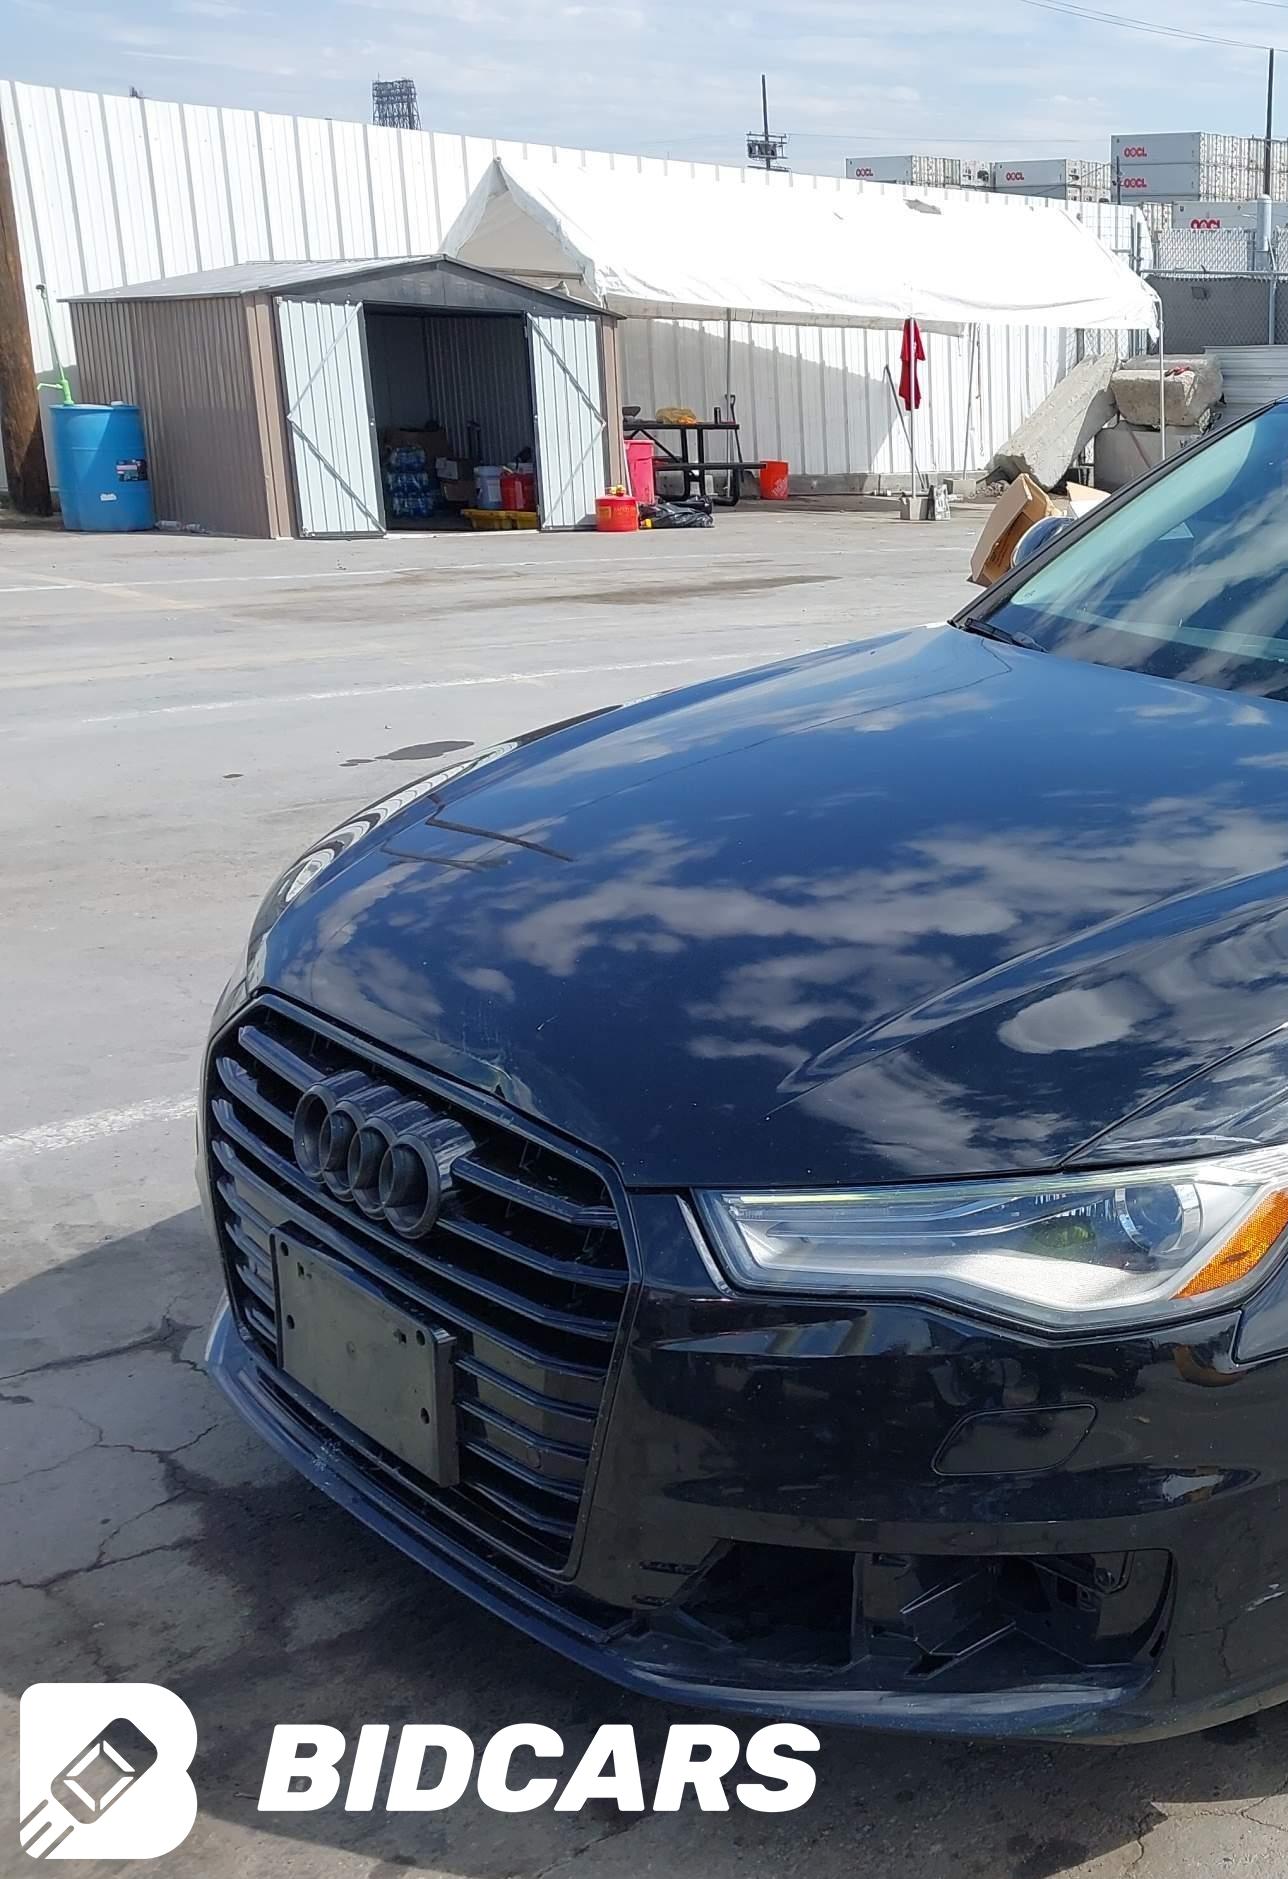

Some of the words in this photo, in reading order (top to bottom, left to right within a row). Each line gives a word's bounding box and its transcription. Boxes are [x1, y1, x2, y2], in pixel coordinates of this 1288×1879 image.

[1124, 147, 1147, 158] OOCL
[856, 168, 874, 177] OOCL
[1006, 172, 1025, 181] OOCL
[1123, 178, 1147, 188] OOCL
